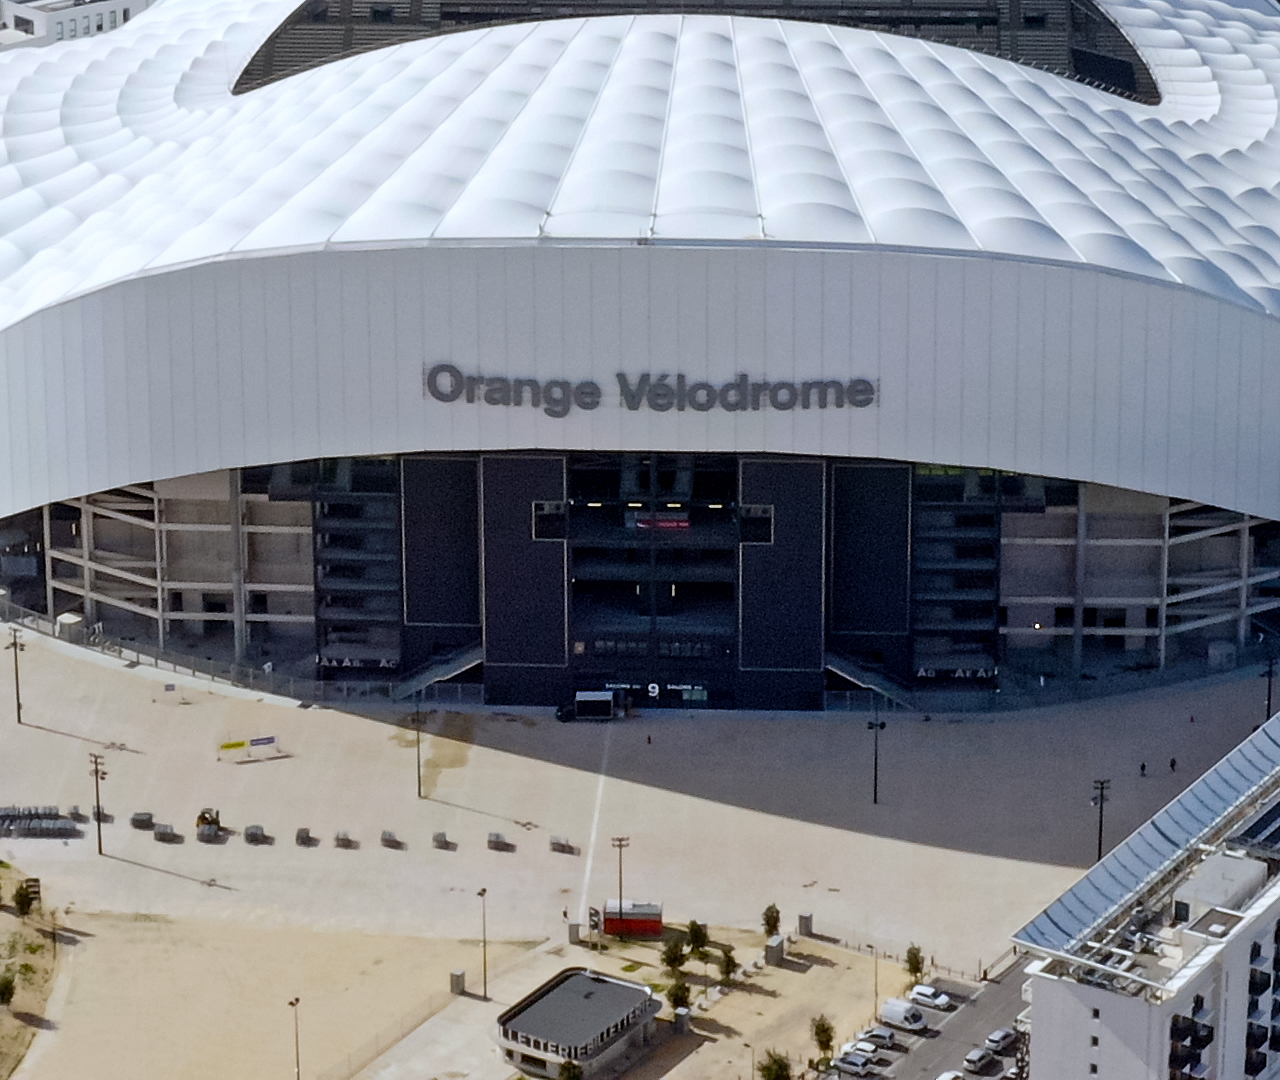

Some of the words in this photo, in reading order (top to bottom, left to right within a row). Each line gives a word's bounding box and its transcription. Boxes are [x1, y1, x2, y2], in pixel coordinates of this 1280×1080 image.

[426, 363, 602, 418] Orange
[616, 371, 875, 412] Vélodrome
[647, 683, 660, 697] 9
